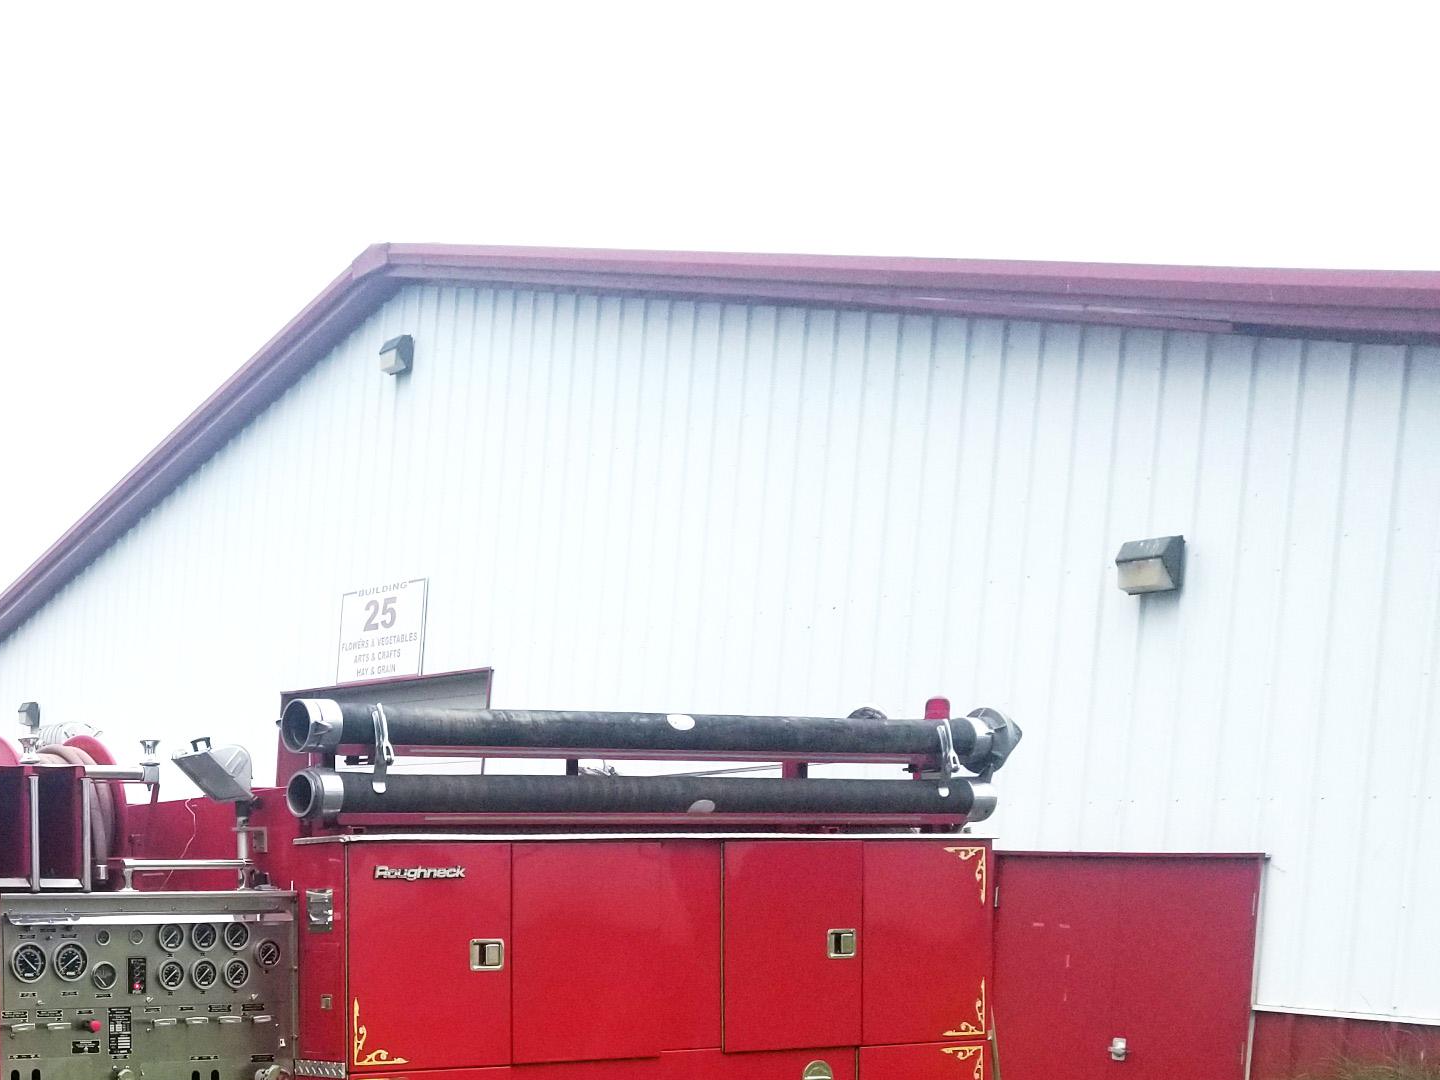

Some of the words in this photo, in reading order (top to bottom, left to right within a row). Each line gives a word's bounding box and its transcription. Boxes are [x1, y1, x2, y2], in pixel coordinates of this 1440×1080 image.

[358, 581, 408, 597] BUILDING
[363, 596, 397, 632] 25
[341, 638, 369, 652] FLOWERS
[377, 632, 418, 647] VEGETABLES
[354, 653, 370, 664] ARTS
[377, 649, 401, 661] CRAFTS
[356, 667, 369, 678] HAY
[377, 664, 396, 675] GRAIN
[375, 865, 466, 882] Roughneck
